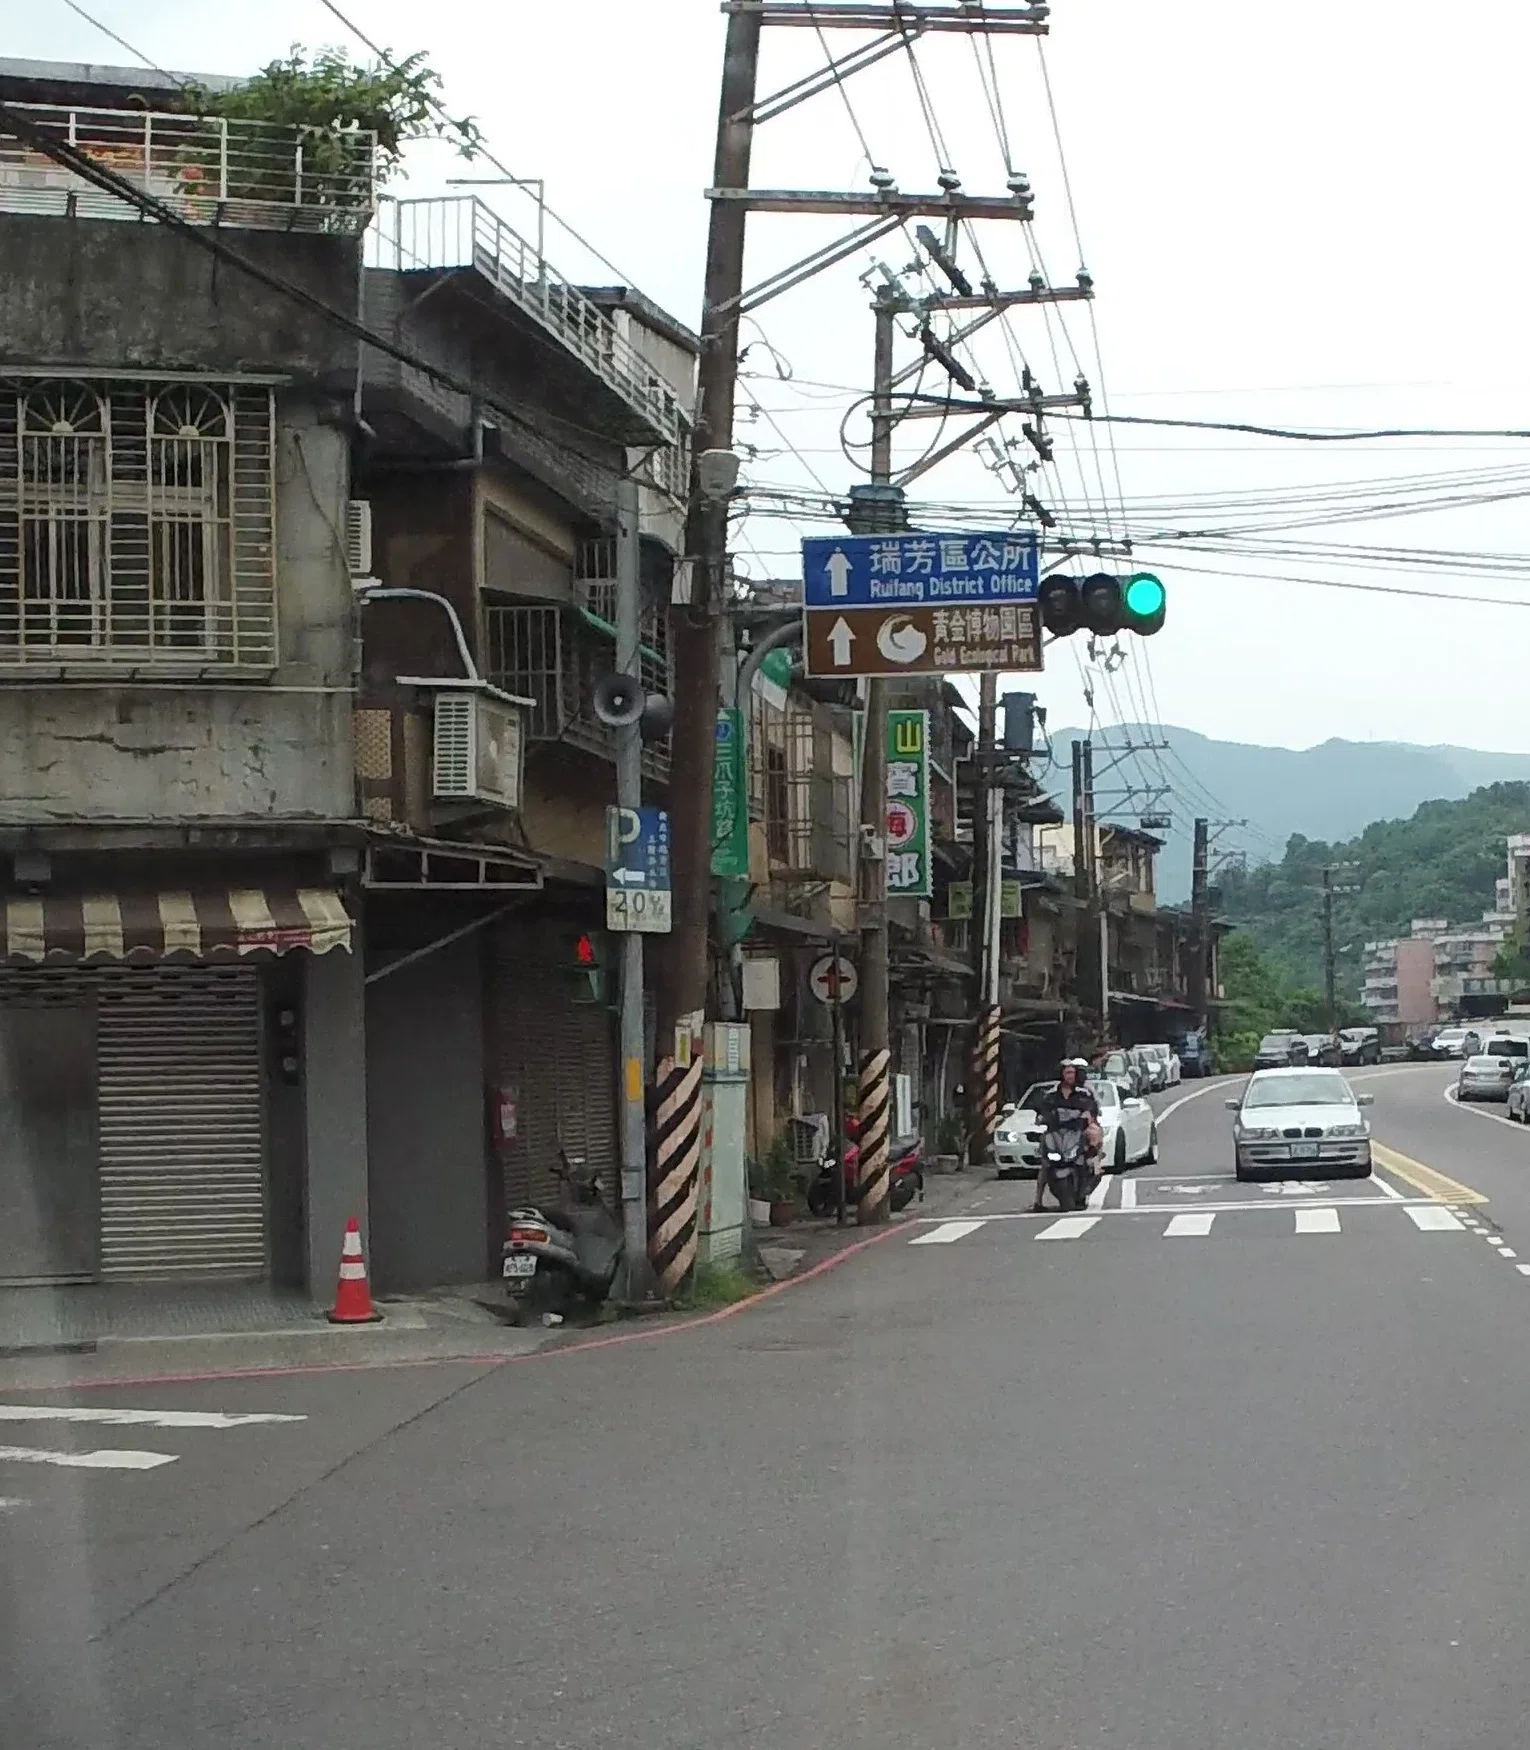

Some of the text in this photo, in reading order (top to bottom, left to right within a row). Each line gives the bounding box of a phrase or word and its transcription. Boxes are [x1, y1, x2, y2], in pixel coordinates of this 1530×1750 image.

[869, 539, 1030, 574] 瑞芳區公所
[870, 575, 1033, 600] Ruifang District Office
